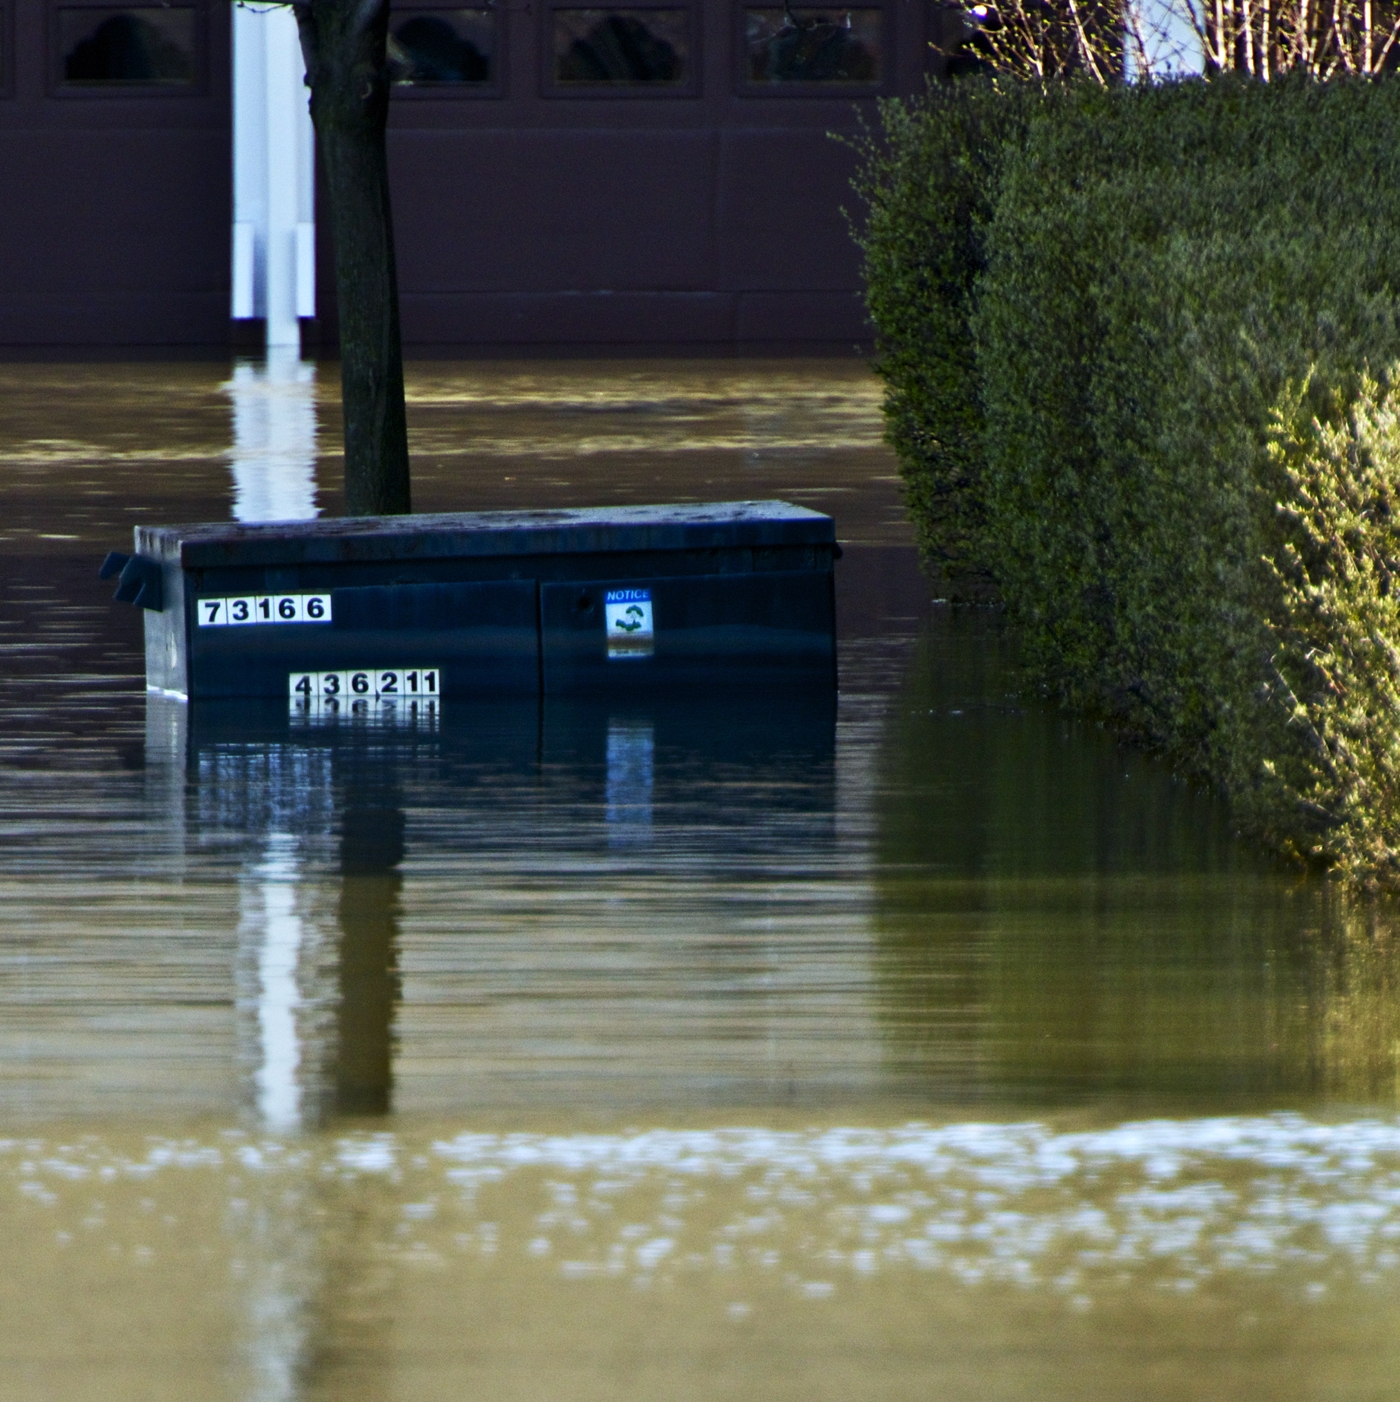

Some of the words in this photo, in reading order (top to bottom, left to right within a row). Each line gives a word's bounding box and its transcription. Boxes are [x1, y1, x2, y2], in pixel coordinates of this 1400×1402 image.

[607, 589, 649, 601] NOTICE
[204, 597, 325, 623] 73166
[295, 671, 436, 695] 436211
